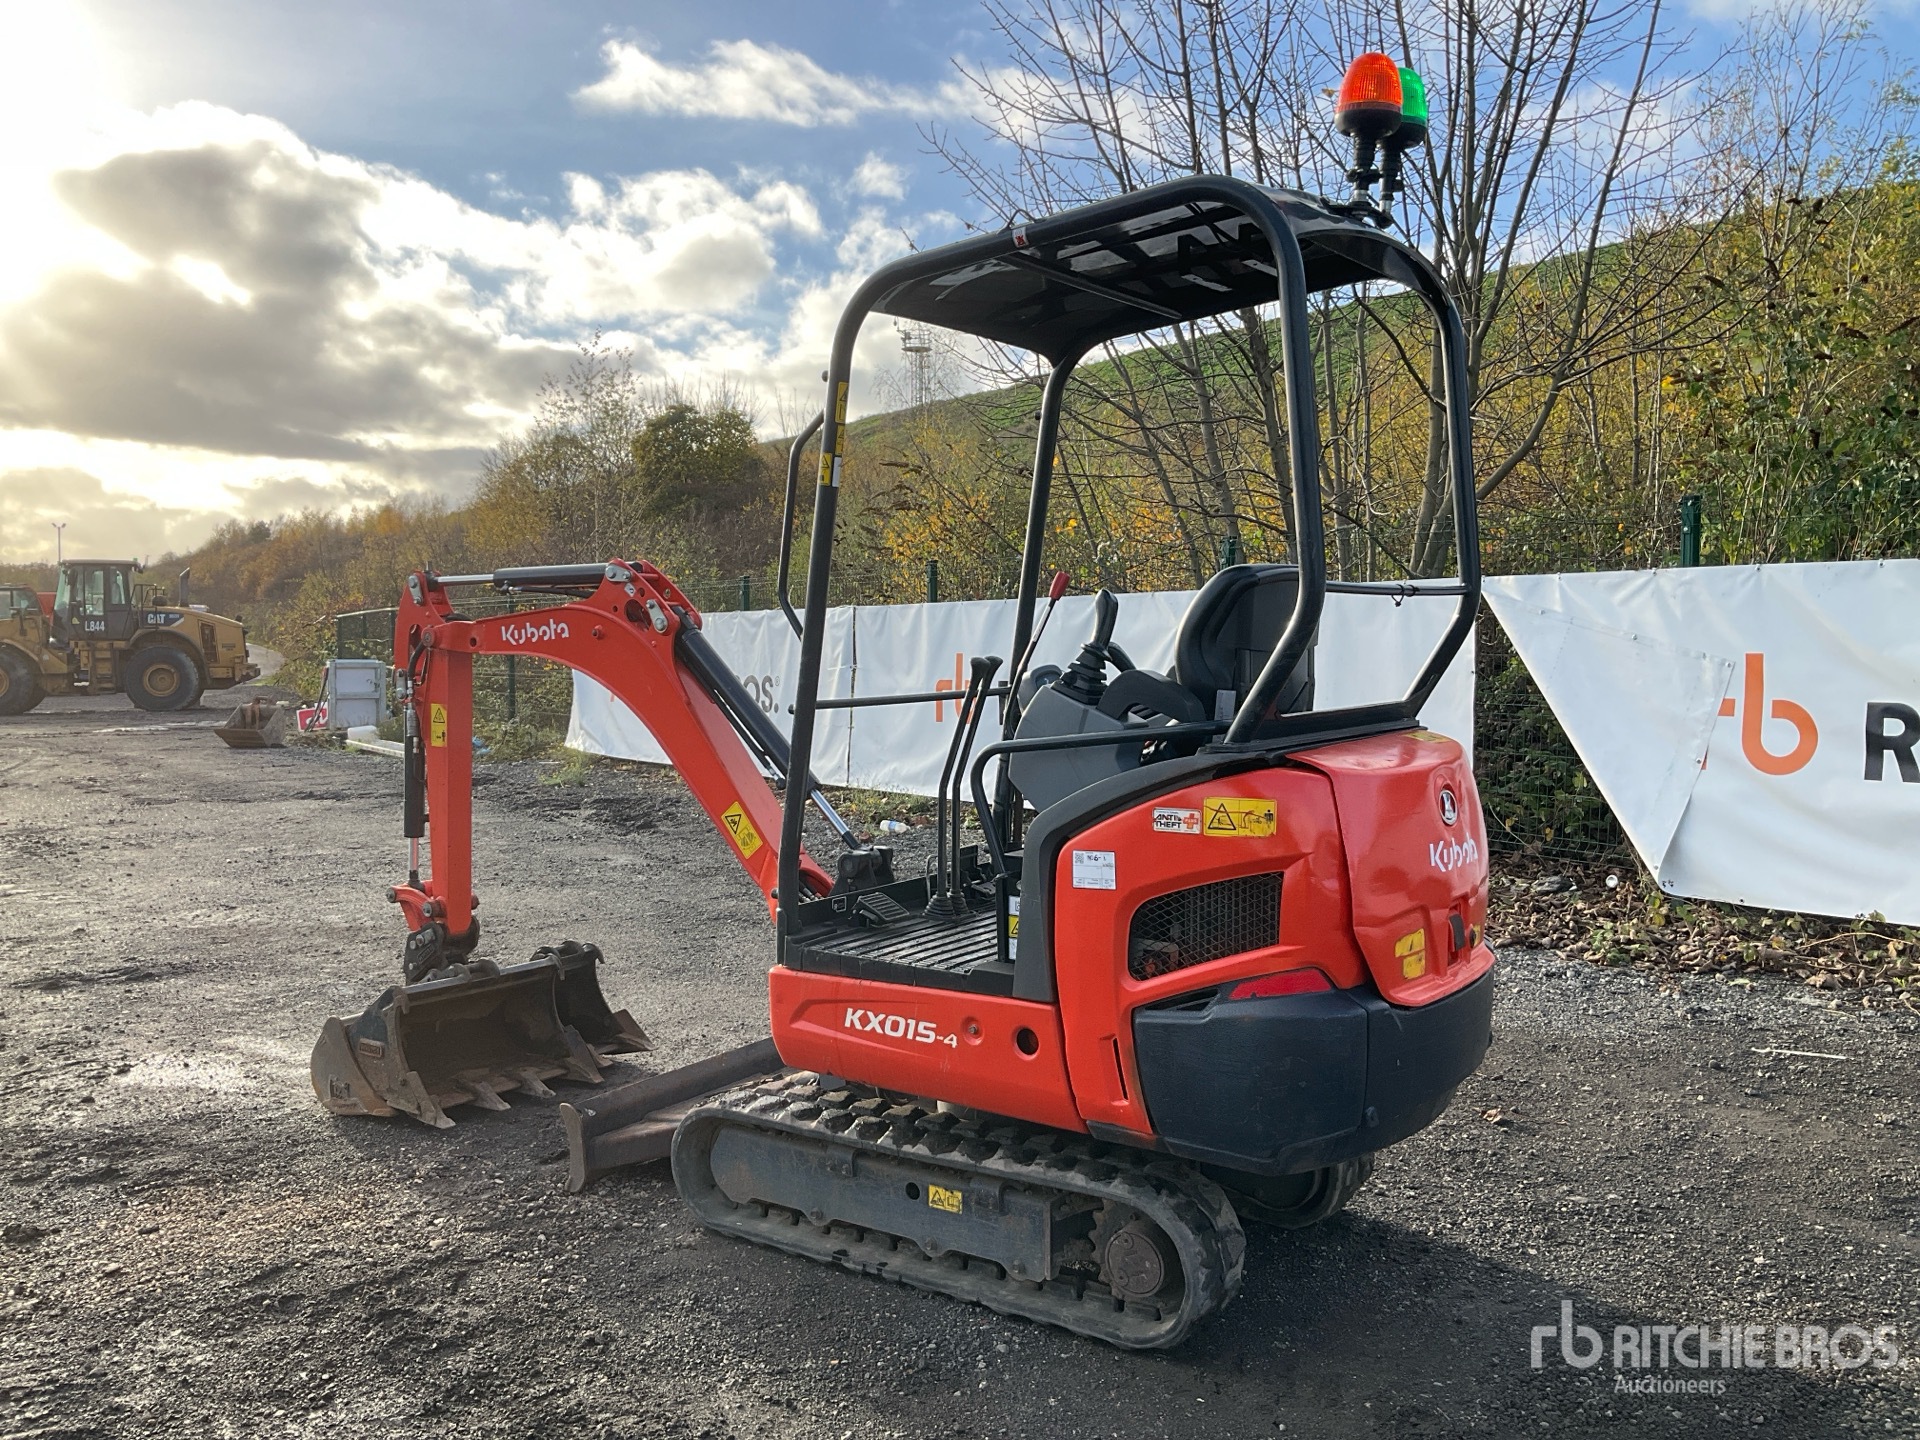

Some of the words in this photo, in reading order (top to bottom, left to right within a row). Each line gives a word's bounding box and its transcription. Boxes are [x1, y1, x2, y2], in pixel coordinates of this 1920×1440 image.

[84, 620, 105, 632] L844
[147, 613, 166, 624] CAT
[501, 618, 570, 646] Kubota
[1700, 652, 1819, 776] b
[1154, 820, 1182, 829] THEFT
[844, 1007, 958, 1049] KX015-4
